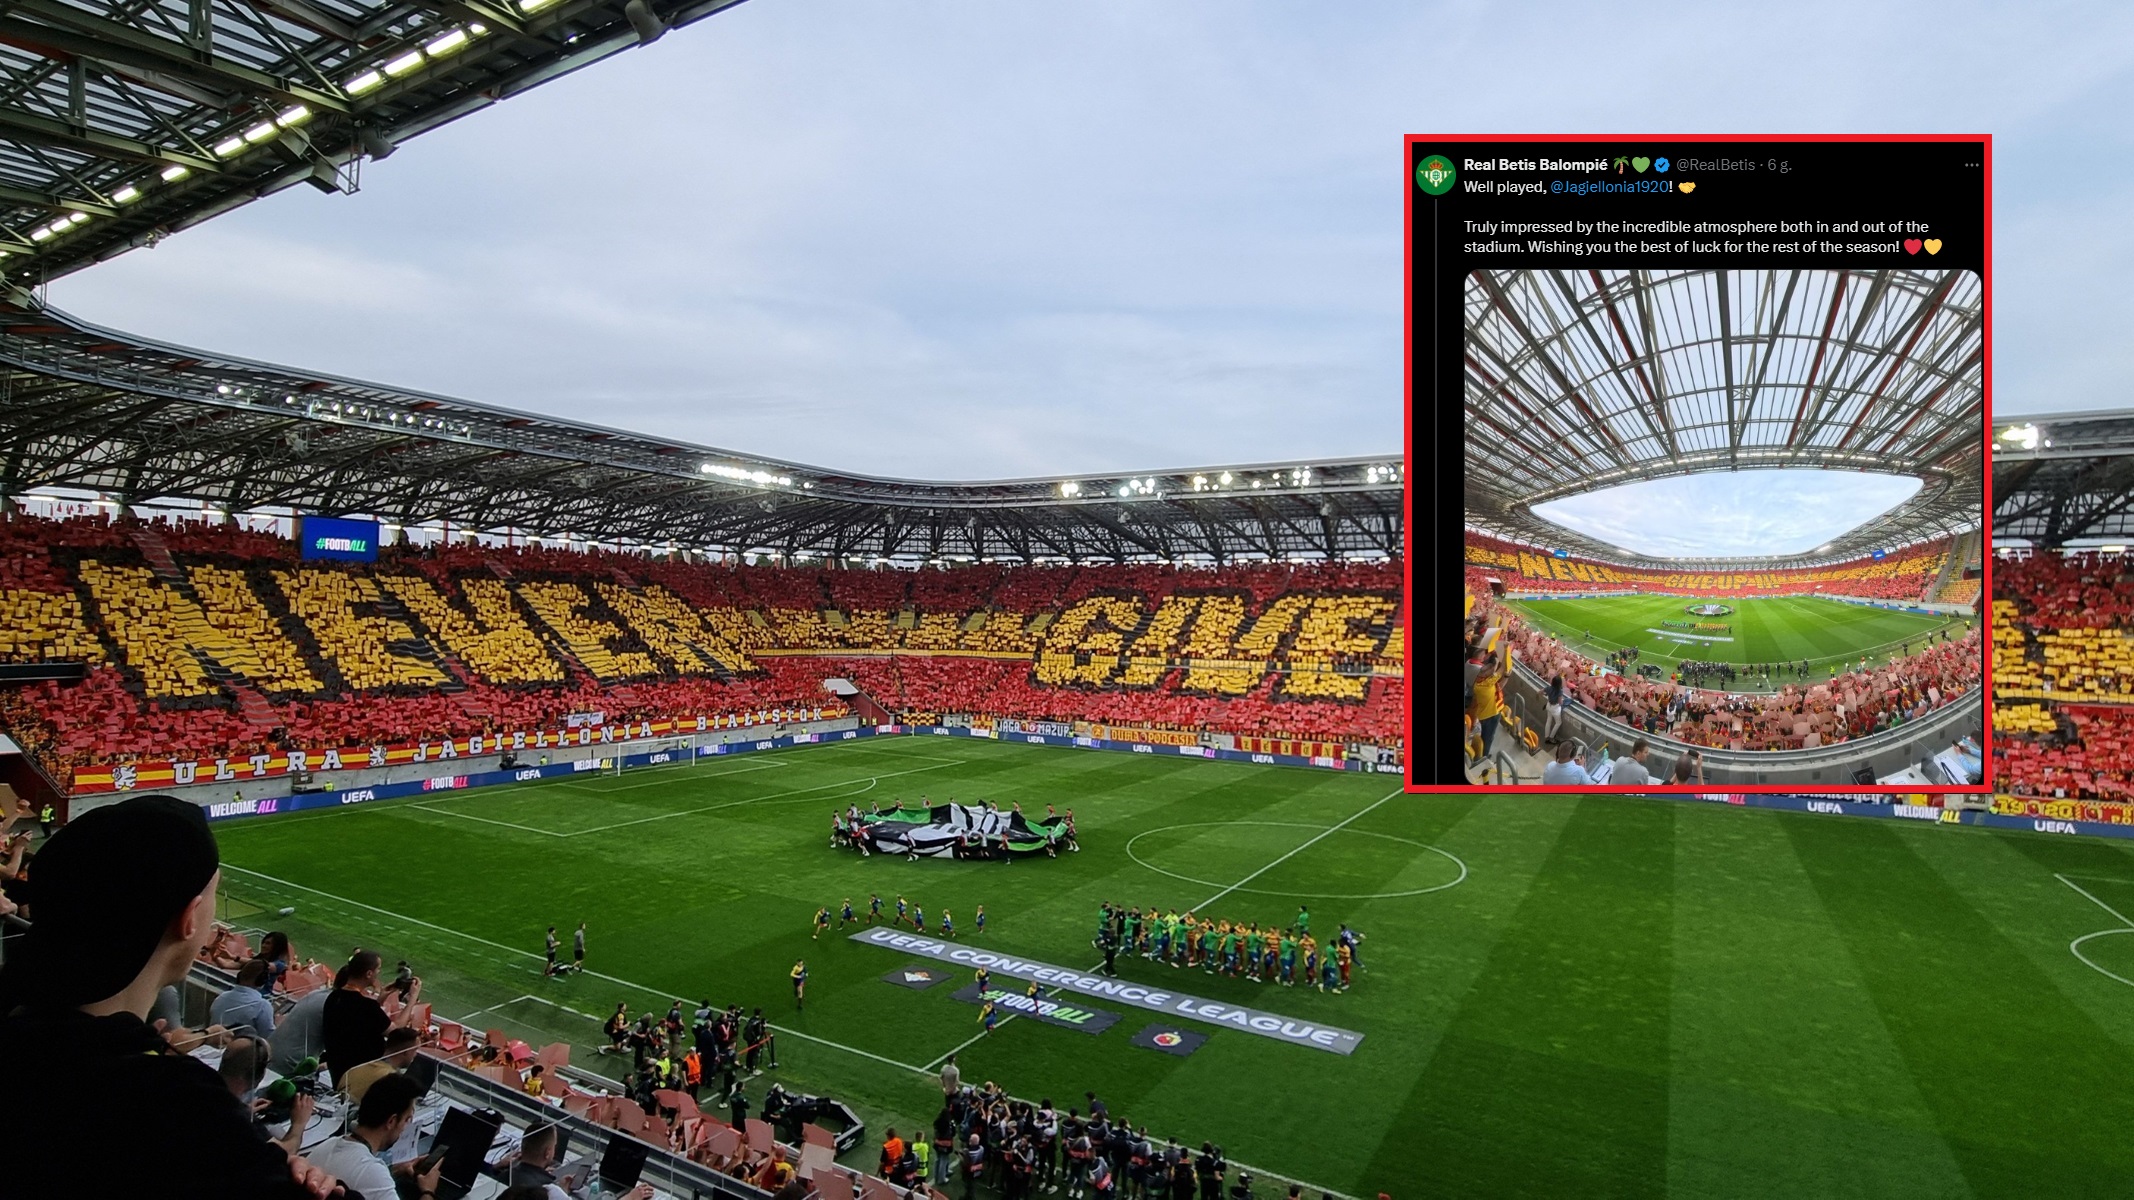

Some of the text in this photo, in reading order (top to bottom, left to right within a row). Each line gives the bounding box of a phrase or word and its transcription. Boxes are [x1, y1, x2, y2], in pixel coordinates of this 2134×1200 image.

[315, 537, 366, 552] #FOOTBALL
[78, 558, 768, 700] NEVER
[1031, 594, 1397, 702] GIVE
[933, 727, 949, 736] UEFA
[998, 719, 1020, 733] JAGA
[842, 730, 857, 740] UEFA
[1027, 735, 1045, 744] UEFA
[173, 707, 822, 785] ULTRA JAGIELLONIA BIAŁYSTOK
[756, 740, 773, 750] UEFA
[1132, 744, 1153, 754] UEFA
[650, 753, 670, 764] UEFA
[1203, 747, 1216, 758] ALL
[1252, 754, 1274, 764] UEFA
[601, 757, 613, 770] ALL
[1377, 764, 1397, 773] UEFA
[515, 768, 541, 781] UEFA
[422, 776, 468, 790] #FOOTBALL
[341, 790, 375, 804] UEFA
[210, 799, 278, 818] WELCOME ALL
[1807, 800, 1843, 815] UEFA
[1893, 803, 1961, 824] WELCOME ALL
[2034, 819, 2076, 835] UEFA
[870, 930, 946, 955] UEFA
[949, 949, 1172, 1006] CONFERENCE
[1176, 999, 1339, 1045] LEAGUE
